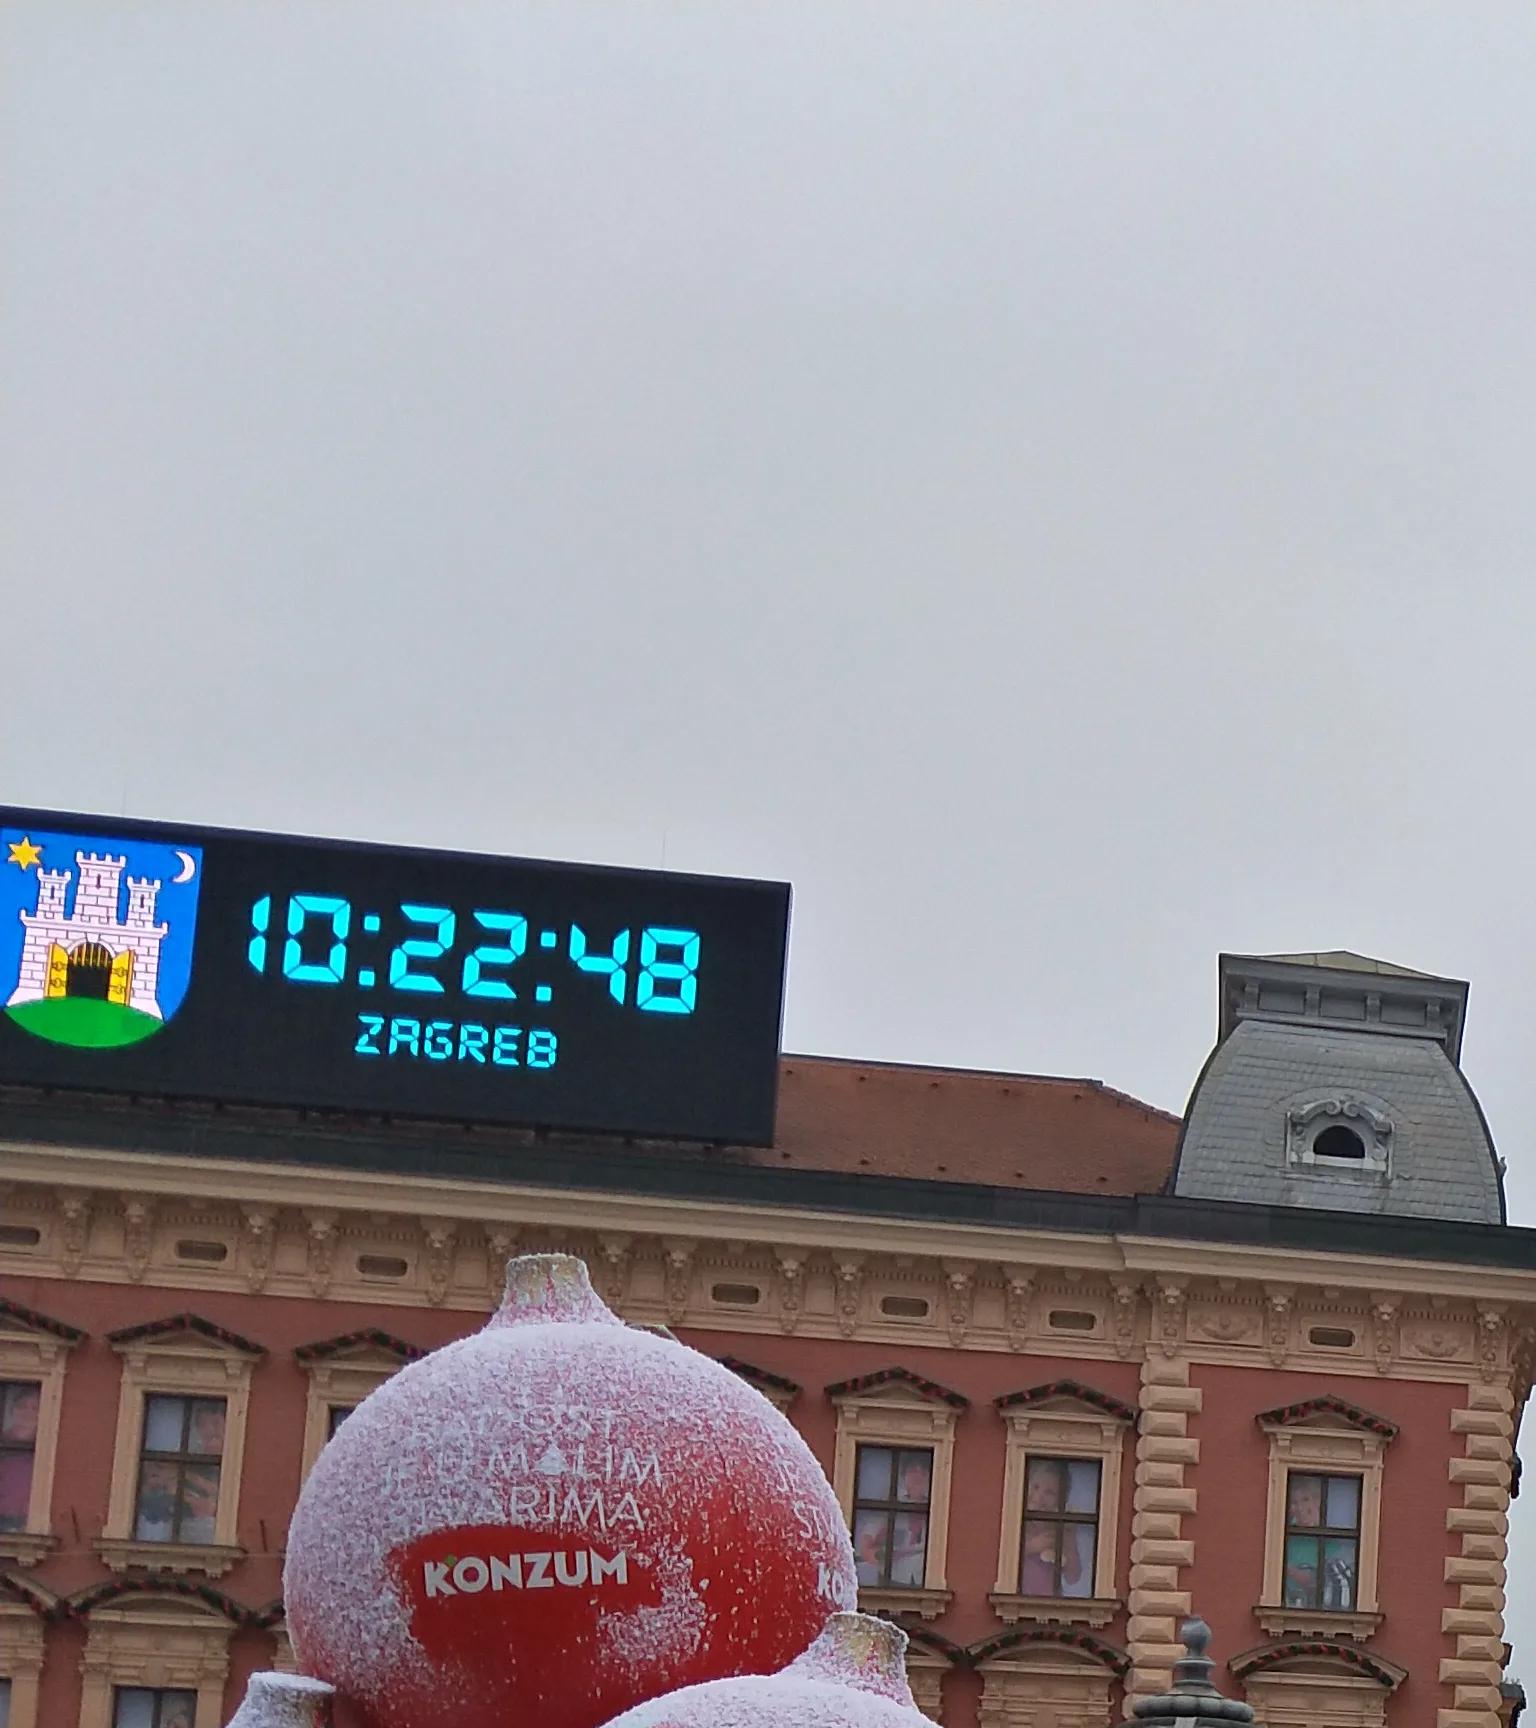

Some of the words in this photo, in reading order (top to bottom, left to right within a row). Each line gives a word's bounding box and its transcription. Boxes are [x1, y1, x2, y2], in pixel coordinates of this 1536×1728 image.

[248, 892, 700, 1014] 10:22:48
[355, 1014, 557, 1068] ZAGREB
[424, 1547, 628, 1598] KONZUM
